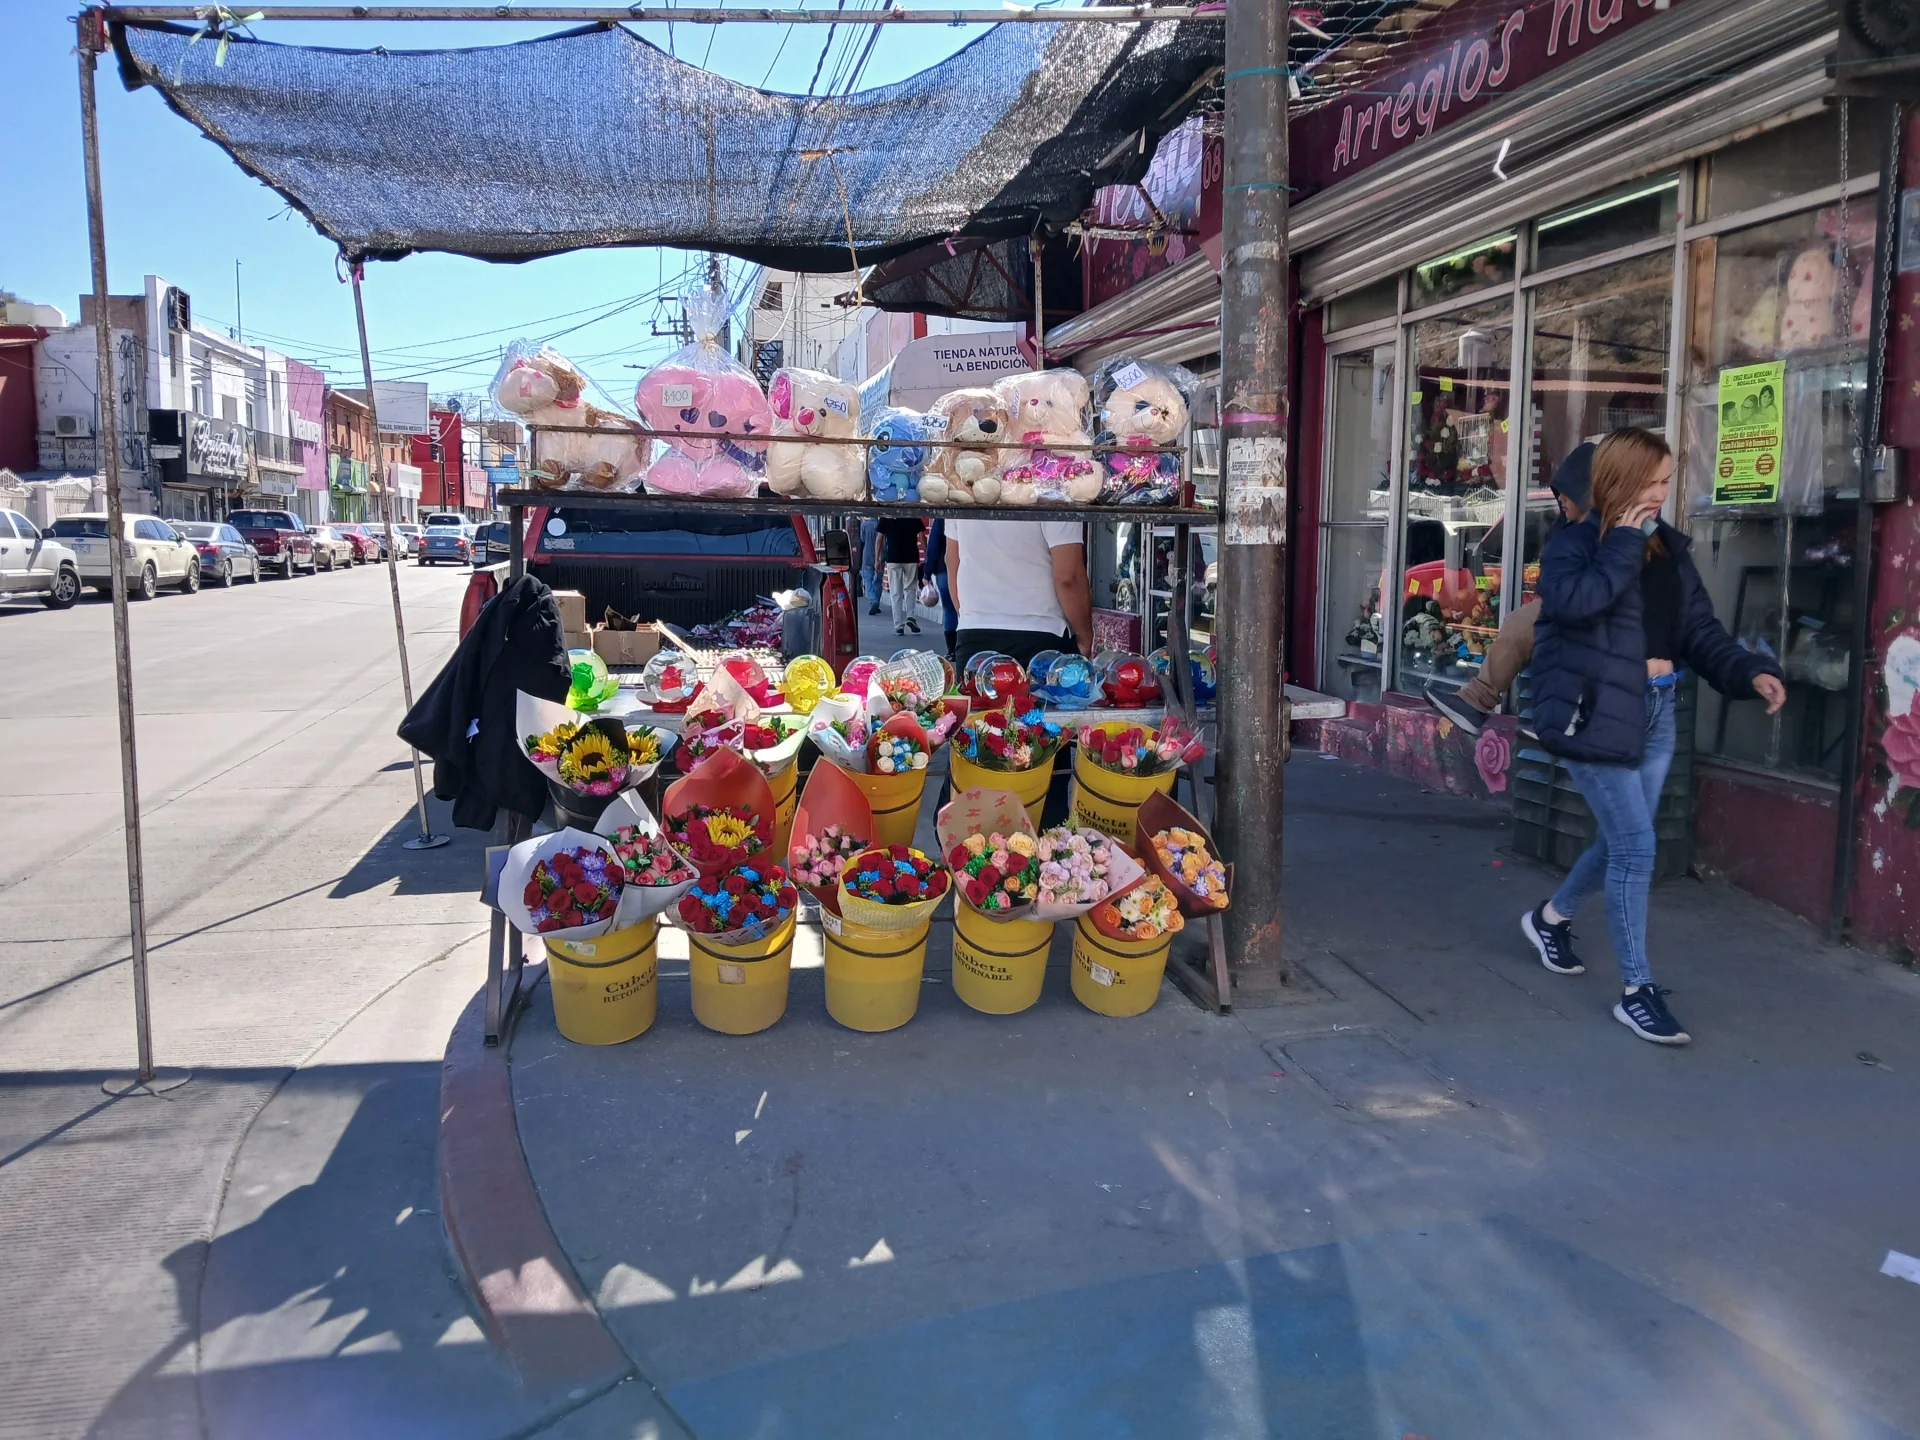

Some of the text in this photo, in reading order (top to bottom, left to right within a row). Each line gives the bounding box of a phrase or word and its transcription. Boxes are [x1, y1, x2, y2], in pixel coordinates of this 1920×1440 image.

[1333, 9, 1525, 172] Arreglos
[933, 349, 976, 360] TIENDA
[1117, 368, 1142, 389] $500
[663, 390, 689, 403] $400
[823, 397, 847, 413] $350
[922, 415, 948, 428] $250
[1746, 429, 1760, 437] salud
[1761, 427, 1777, 436] visual
[1076, 800, 1127, 828] Cubeta
[955, 942, 1007, 973] Cubeta
